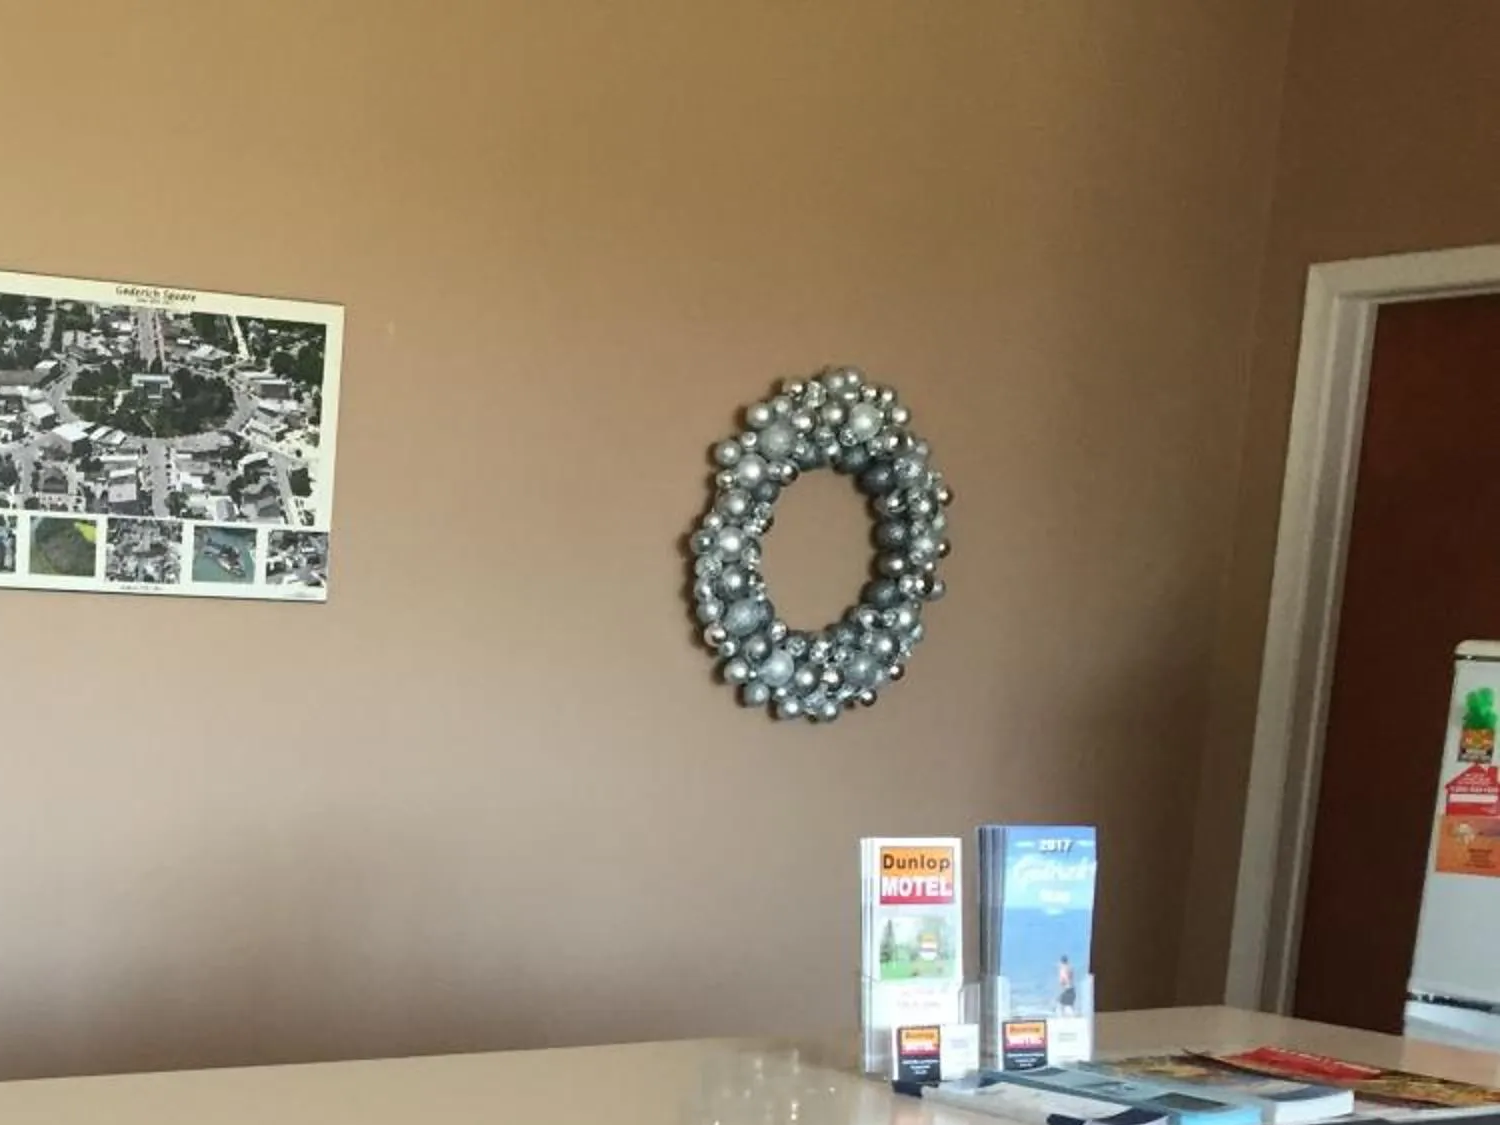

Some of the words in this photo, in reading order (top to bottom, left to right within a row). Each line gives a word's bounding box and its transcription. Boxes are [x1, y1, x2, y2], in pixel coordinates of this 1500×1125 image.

[1038, 838, 1073, 853] 2017
[882, 854, 951, 872] Dunlop
[881, 877, 953, 897] MOTEL
